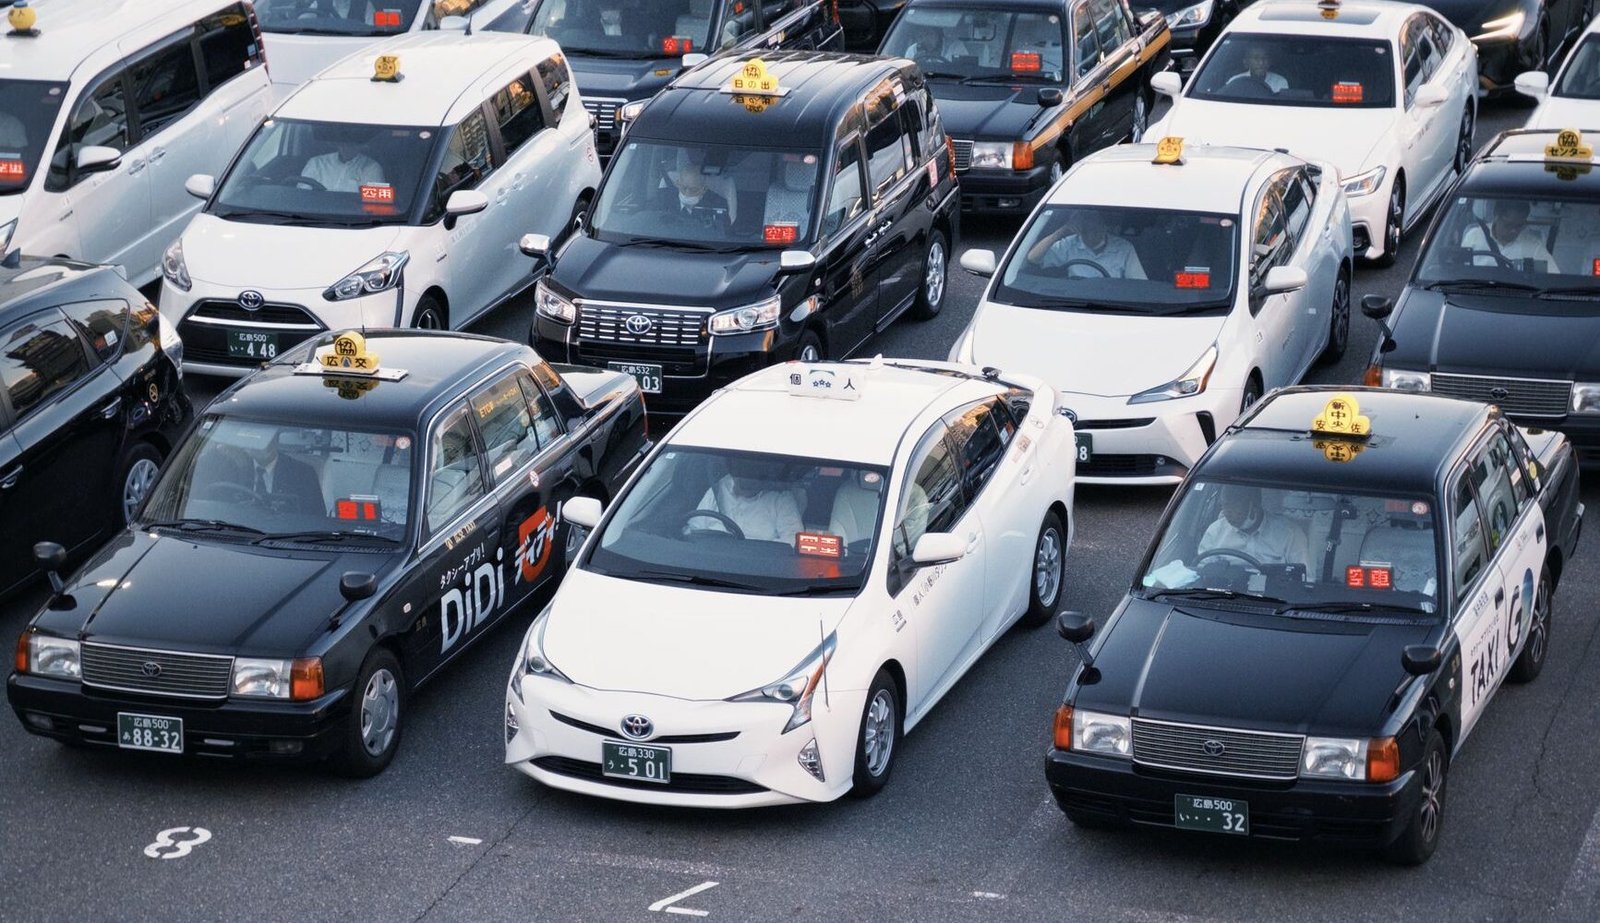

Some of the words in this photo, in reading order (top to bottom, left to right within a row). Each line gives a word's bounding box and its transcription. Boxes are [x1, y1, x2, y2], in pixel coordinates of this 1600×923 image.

[735, 79, 770, 90] 日の出
[1549, 147, 1587, 157] センター
[239, 333, 267, 342] 広島500
[337, 339, 356, 354] 協
[441, 547, 504, 654] DiDi
[1471, 629, 1499, 707] TAXI
[133, 717, 169, 730] 広島500
[133, 728, 180, 750] 88-32
[618, 746, 655, 760] 広島330
[1193, 798, 1233, 812] 広島500
[144, 827, 212, 859] 8
